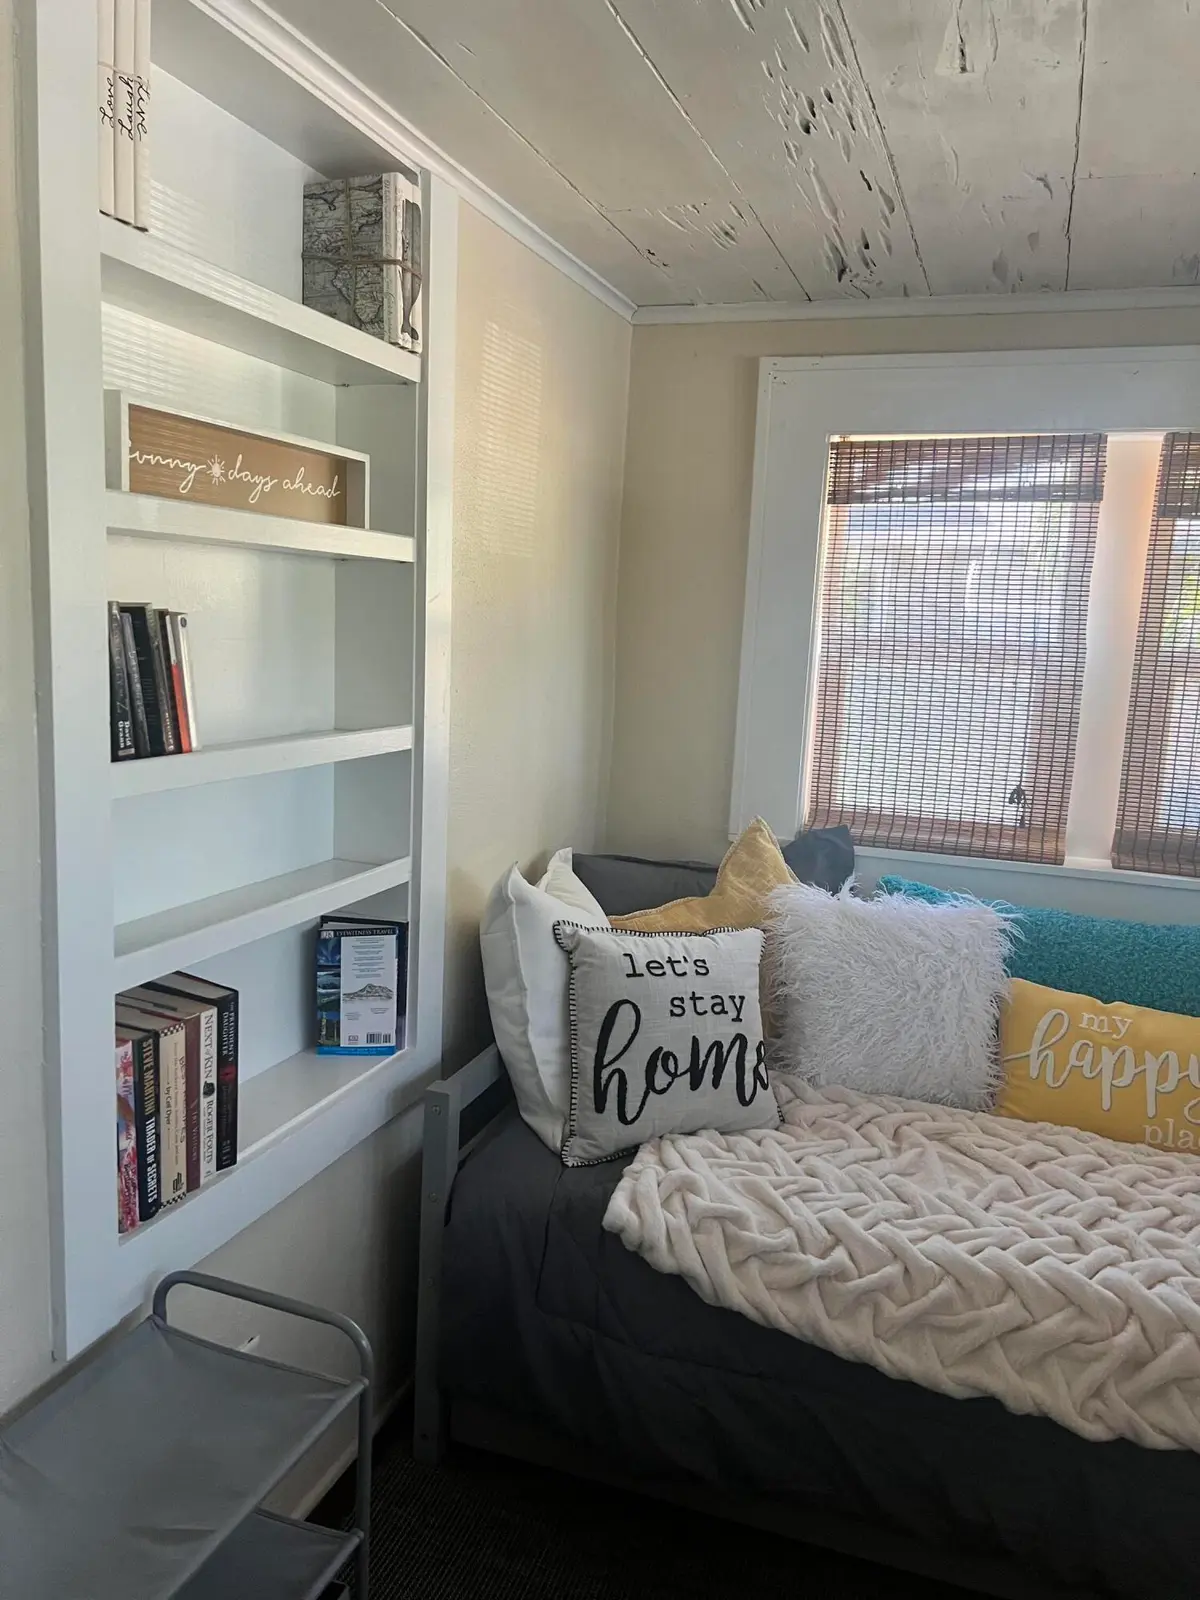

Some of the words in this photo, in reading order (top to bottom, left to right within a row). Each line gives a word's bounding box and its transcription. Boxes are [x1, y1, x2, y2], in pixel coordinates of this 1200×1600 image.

[129, 449, 206, 493] unny
[228, 454, 277, 503] days
[281, 467, 341, 498] ahead
[117, 720, 125, 748] Grann
[124, 720, 132, 746] David
[623, 953, 710, 978] let's
[669, 991, 746, 1022] stay
[204, 1014, 214, 1049] NEXT
[1078, 1012, 1133, 1040] my
[142, 1038, 154, 1070] STEVE
[204, 1055, 214, 1079] KIN
[144, 1070, 155, 1115] MARTINI
[165, 1086, 172, 1095] by
[206, 1100, 214, 1133] ROGER
[145, 1116, 156, 1154] TRADER
[205, 1133, 213, 1164] FOUTS
[147, 1164, 158, 1203] SECRETS
